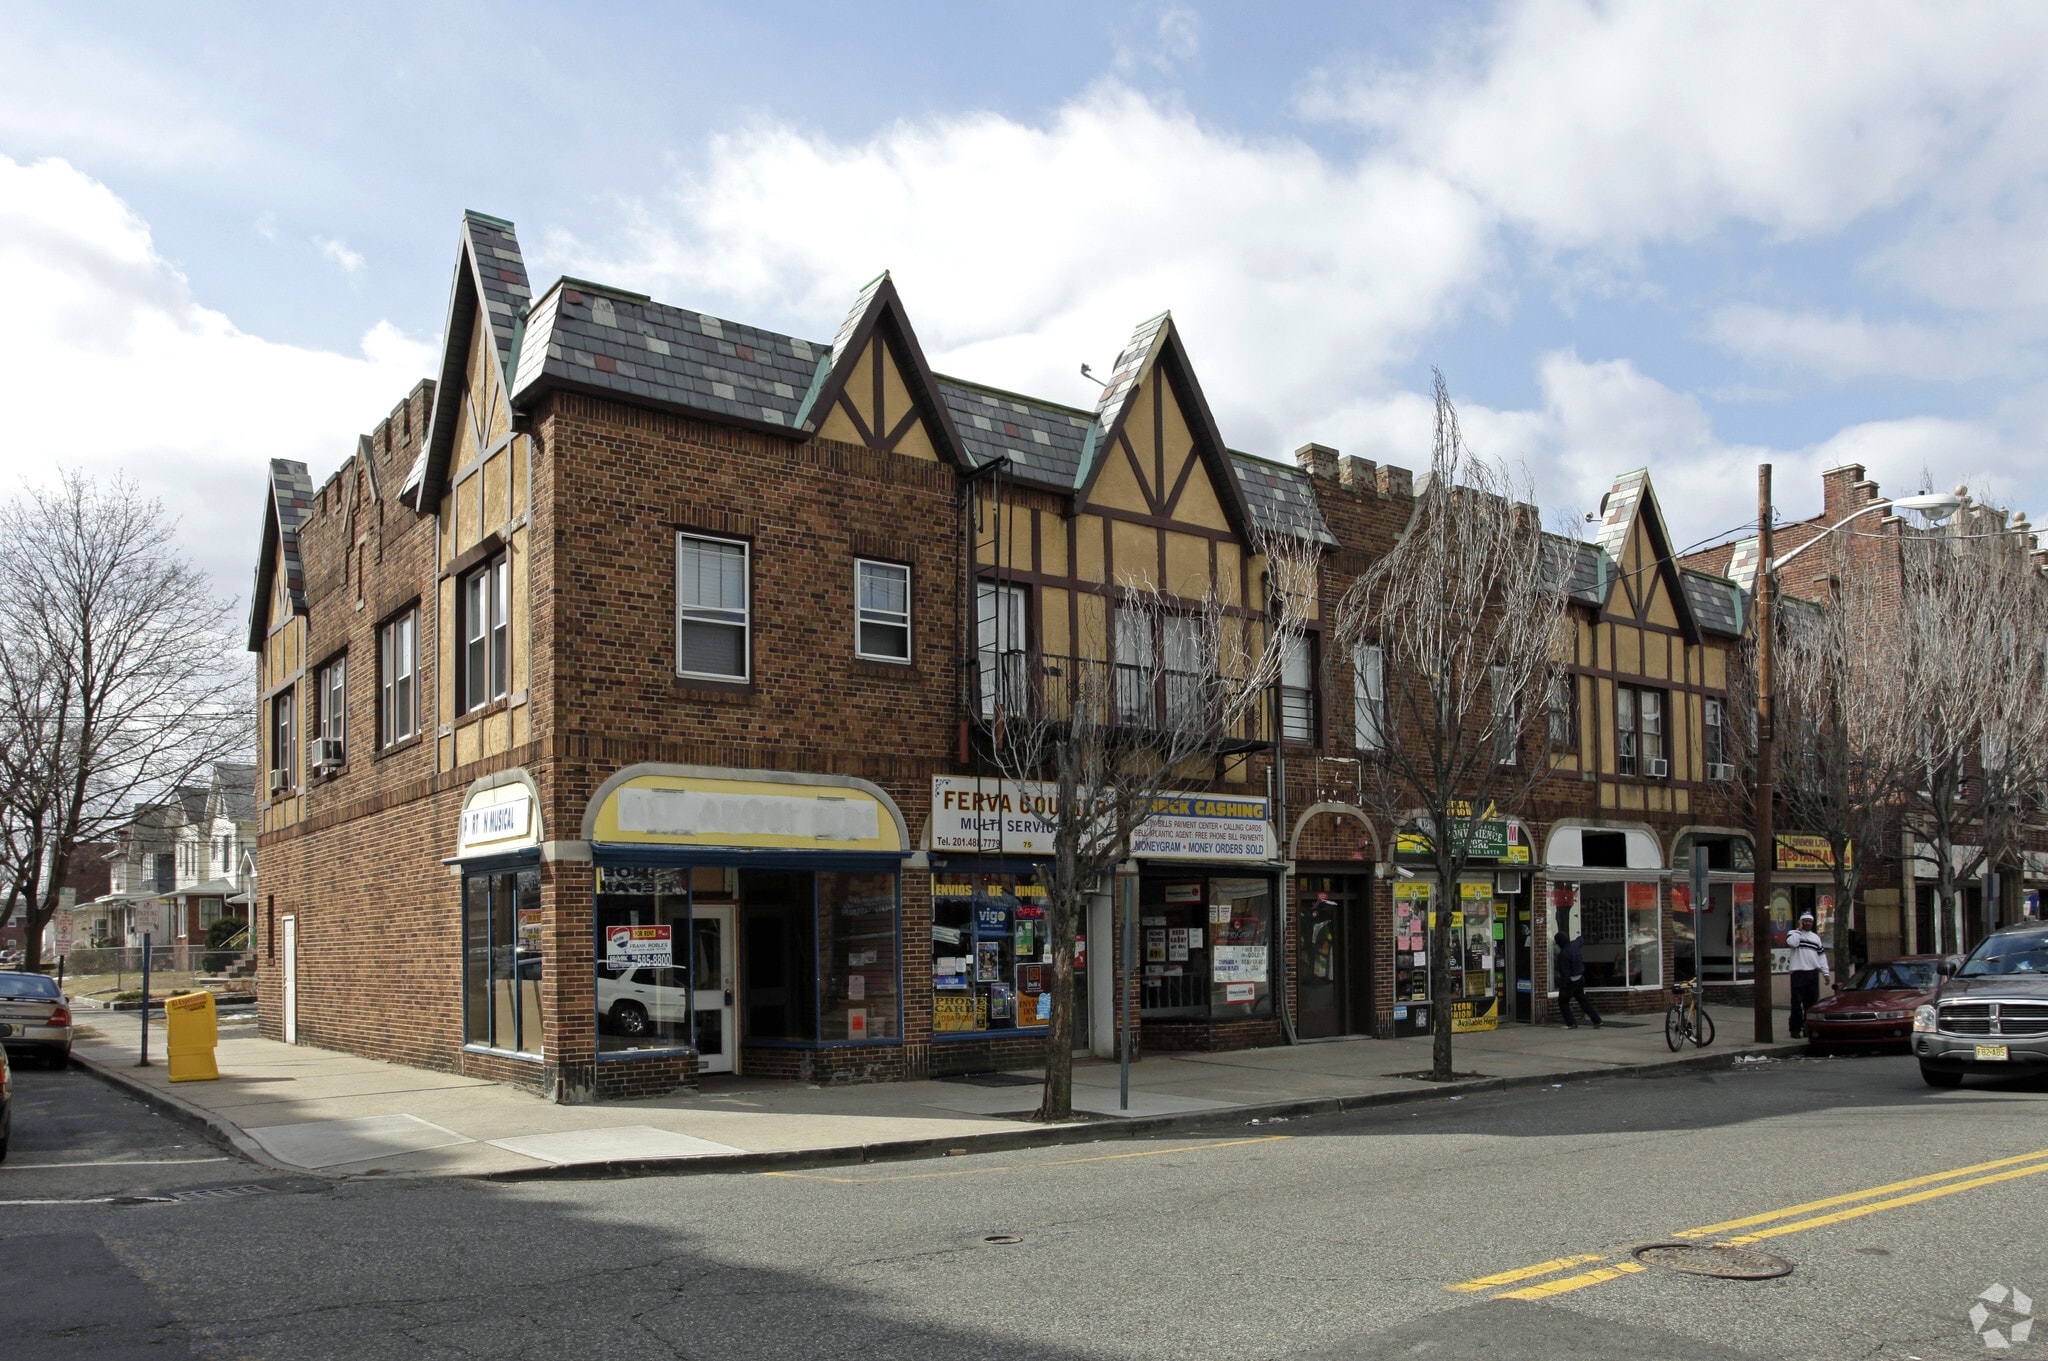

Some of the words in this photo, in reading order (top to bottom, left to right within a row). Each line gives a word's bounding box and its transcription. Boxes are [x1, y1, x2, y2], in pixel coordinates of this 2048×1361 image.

[944, 791, 1012, 813] FERVA
[1195, 801, 1264, 819] CASHING
[489, 807, 514, 833] MUSICAL
[1158, 820, 1172, 828] BILLS
[1174, 821, 1197, 829] PAYMENT
[1223, 823, 1243, 831] CALLING
[937, 836, 951, 846] Tel.
[1134, 829, 1148, 837] BELL
[1148, 830, 1173, 838] ATLANTIC
[1209, 832, 1226, 840] PHONE
[1228, 833, 1238, 841] BILL
[1135, 841, 1180, 852] MONEYGRAM
[1188, 843, 1213, 853] MONEY
[1215, 843, 1243, 854] ORDERS
[1246, 844, 1264, 855] SOLD
[935, 884, 972, 896] ENVIOS
[988, 885, 1003, 897] DE
[979, 907, 1006, 924] vigo
[1017, 907, 1042, 916] OPEN
[637, 954, 671, 967] 585-8800
[935, 997, 986, 1005] PHONE
[935, 1005, 986, 1013] CARDS
[1457, 1018, 1482, 1027] Available
